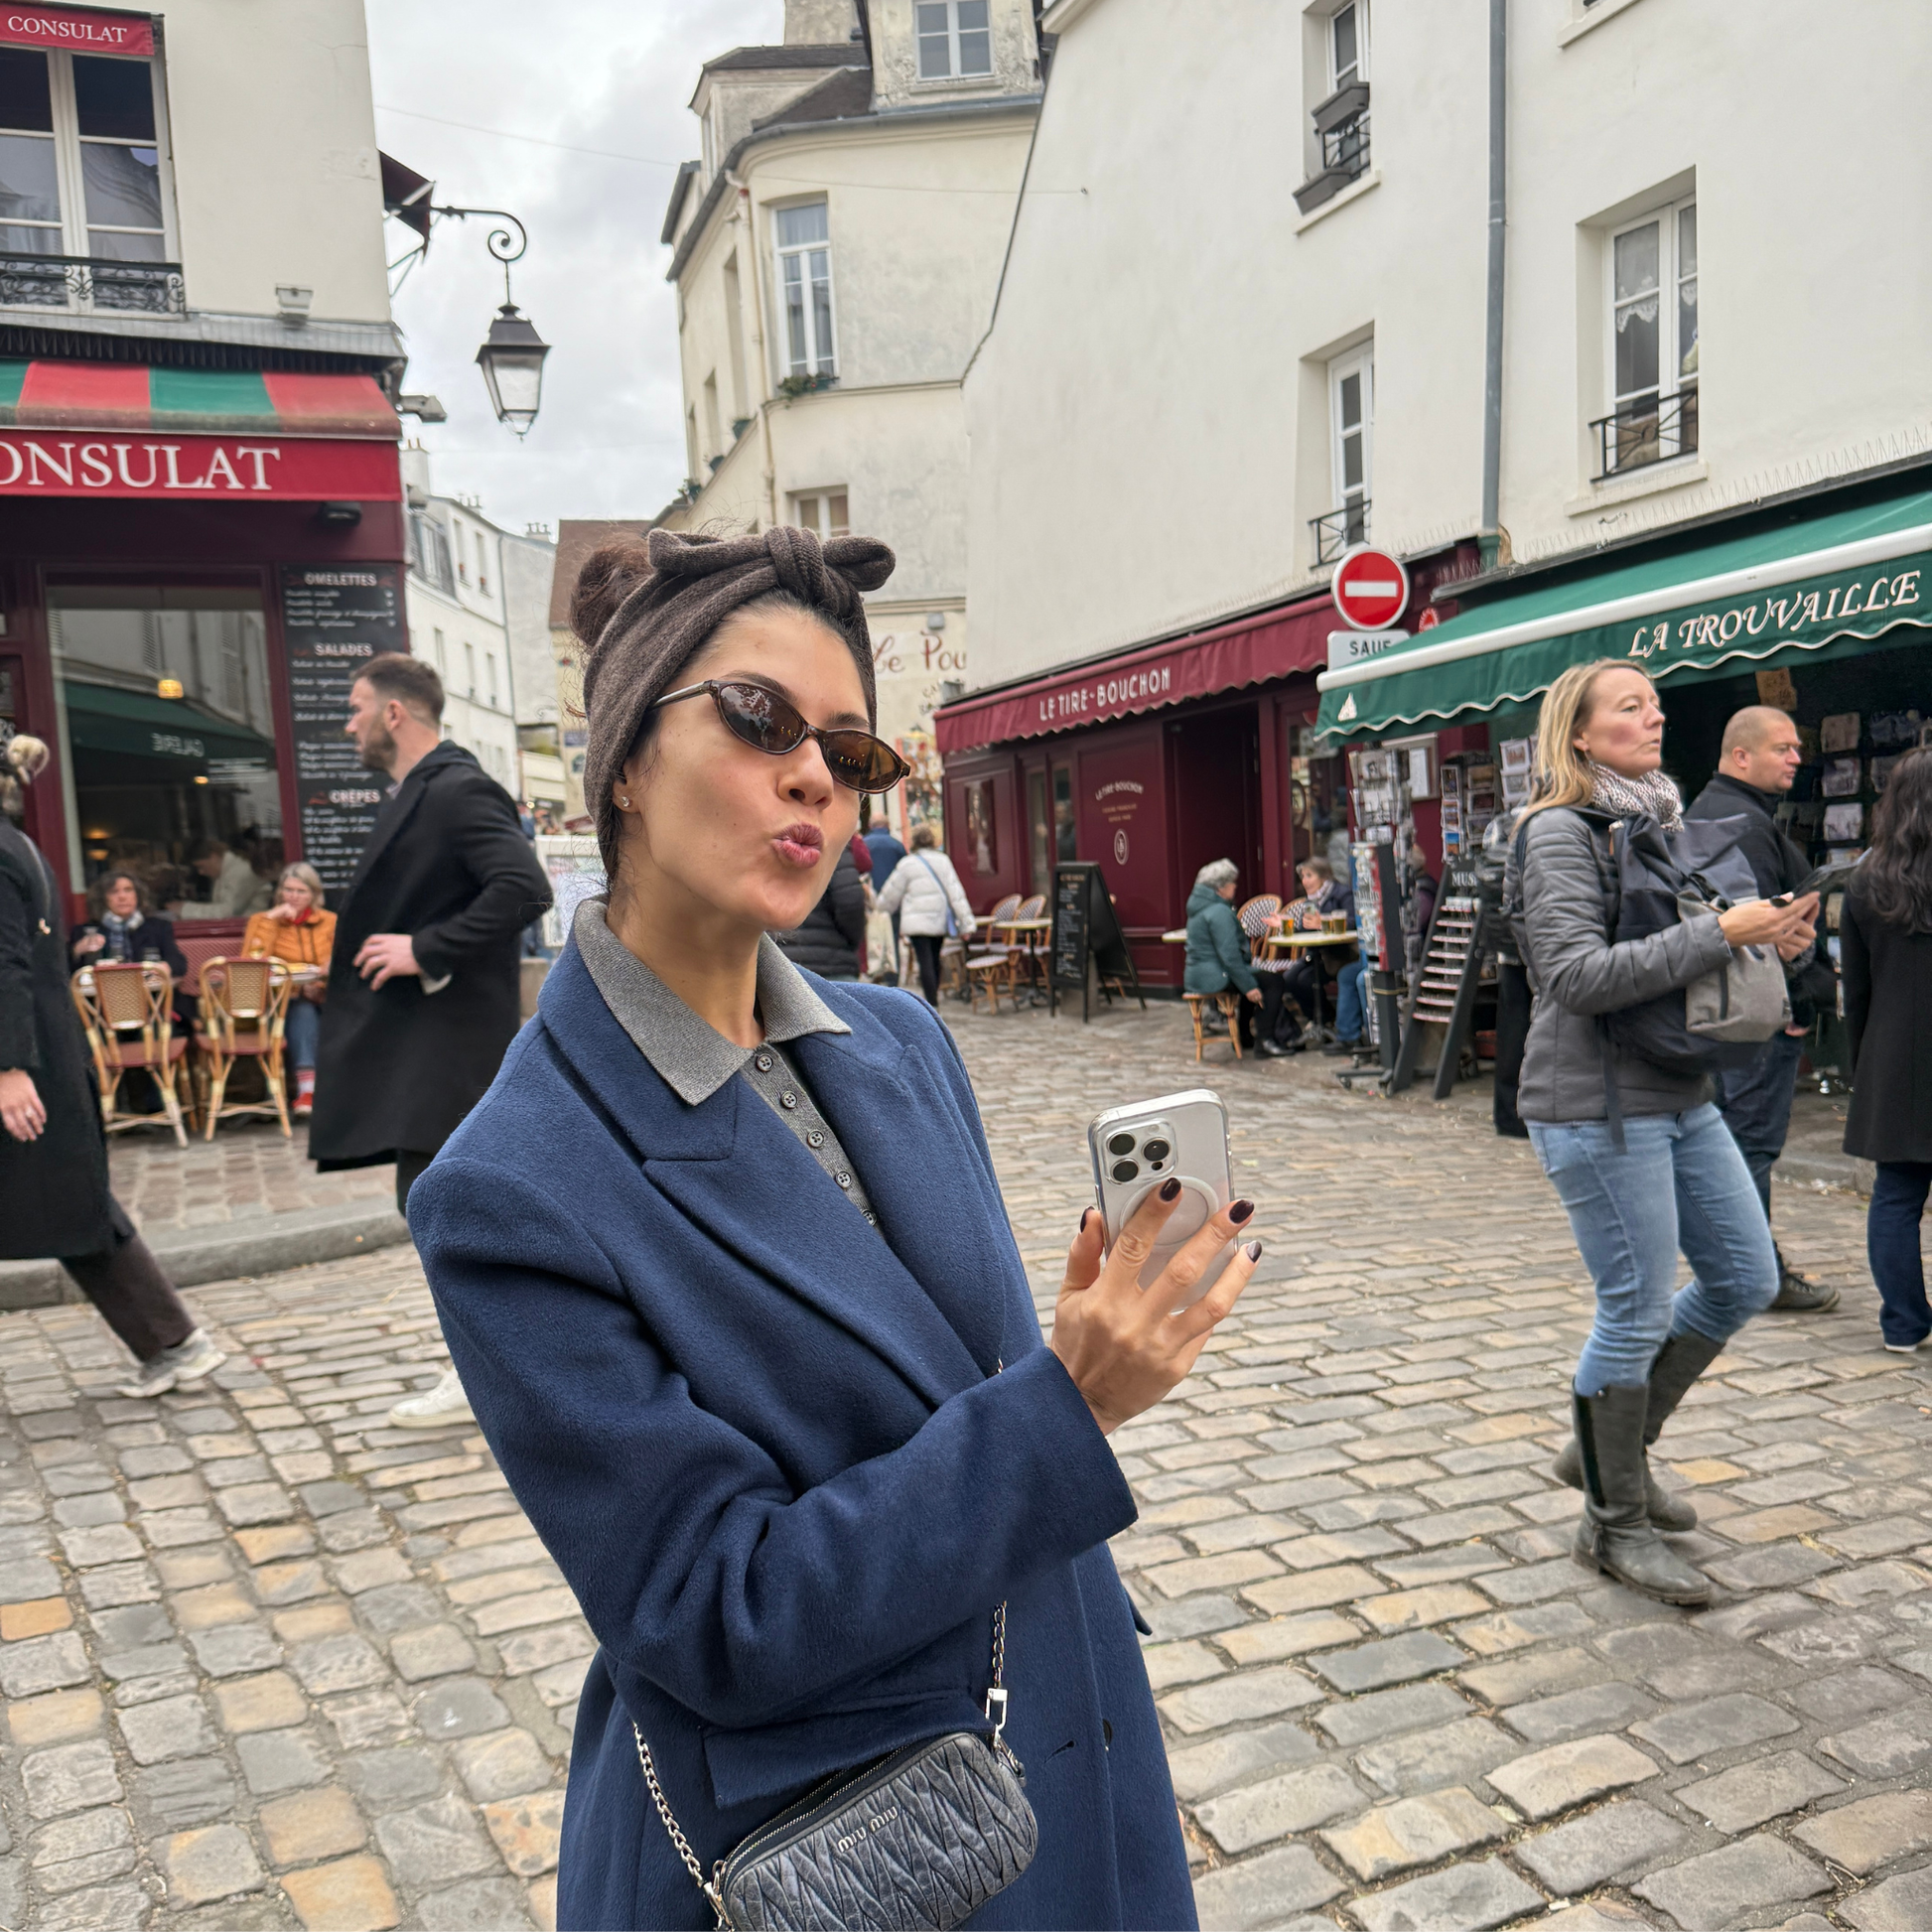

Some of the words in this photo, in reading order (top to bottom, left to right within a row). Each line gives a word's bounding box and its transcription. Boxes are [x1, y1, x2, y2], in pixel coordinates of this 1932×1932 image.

[7, 16, 127, 43] CONSULAT
[304, 571, 377, 586] OMELETTES
[1627, 621, 1670, 658] LA
[1678, 570, 1921, 648] TROUVAILLE
[314, 643, 373, 656] SALADES
[1039, 697, 1055, 721] LE
[1451, 871, 1476, 887] MUS
